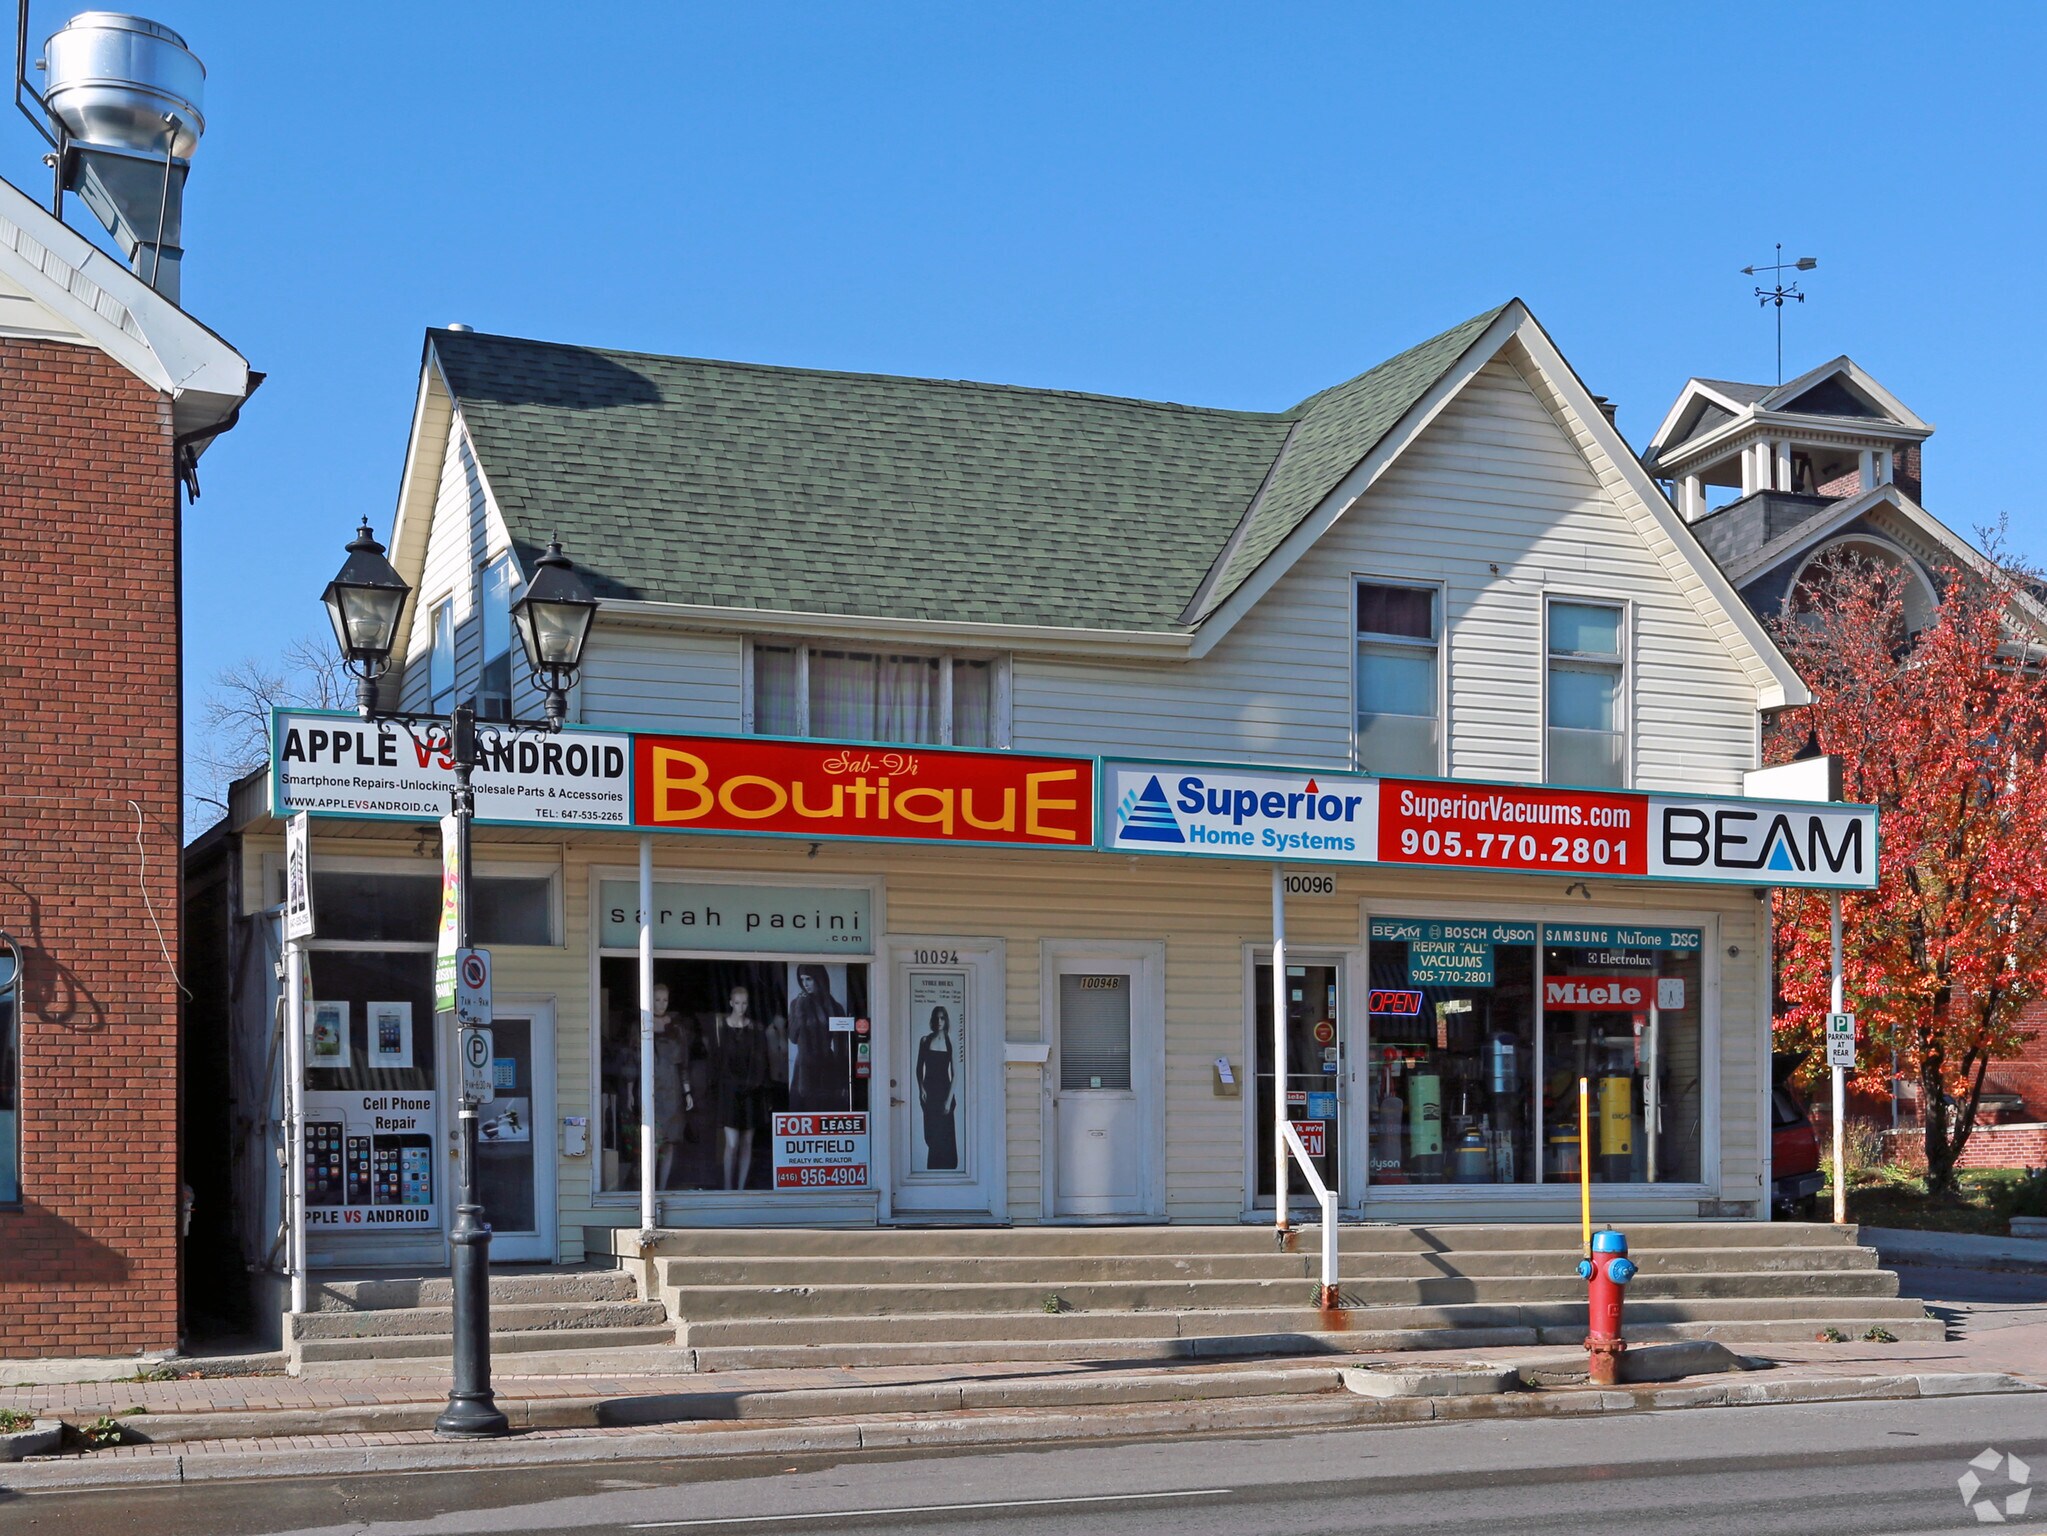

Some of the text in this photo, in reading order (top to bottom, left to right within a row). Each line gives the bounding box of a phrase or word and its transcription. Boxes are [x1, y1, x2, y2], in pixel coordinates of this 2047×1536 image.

[281, 728, 398, 767] APPLE
[281, 773, 350, 788] Smartphone
[470, 782, 516, 795] holesale
[517, 785, 545, 798] Parts
[548, 788, 556, 798] &
[558, 788, 623, 802] Accessories
[652, 745, 1077, 841] BoutiquE
[283, 796, 439, 813] WWW.APPLEVSANDROID.CA
[1176, 776, 1362, 826] Superior
[1400, 789, 1631, 829] SuperiorVacuums.com
[535, 808, 624, 821] TEL: 647-535-2265
[1189, 823, 1356, 853] Home Systems
[1662, 806, 1862, 875] BEAM
[1400, 828, 1628, 866] 905.770.2801
[1283, 875, 1334, 895] 10096
[746, 909, 859, 933] pacini
[825, 934, 863, 943] .com
[1371, 925, 1699, 947] BEAM BOSCH dyson SAMSUNG NuTone DSC
[1412, 941, 1456, 953] REPAIR
[913, 949, 960, 965] 10094
[1420, 955, 1483, 968] VACUUMS
[1600, 952, 1652, 966] Electrolux
[1081, 977, 1119, 989] 10094B
[1411, 969, 1492, 983] 905-770-2801
[1368, 991, 1420, 1013] OPEN
[1546, 983, 1642, 1005] Miele
[1836, 1016, 1846, 1032] P
[1827, 1033, 1854, 1041] PARKING
[362, 1097, 431, 1111] Cell Phone
[375, 1116, 416, 1132] Repair
[776, 1117, 861, 1135] FOR LEASE
[786, 1140, 855, 1154] DUTFIELD
[825, 1156, 853, 1164] REALTOR
[1369, 1157, 1401, 1171] dyson
[777, 1167, 866, 1185] (416) 956-4904
[305, 1209, 429, 1224] PPLE VS ANDROID
